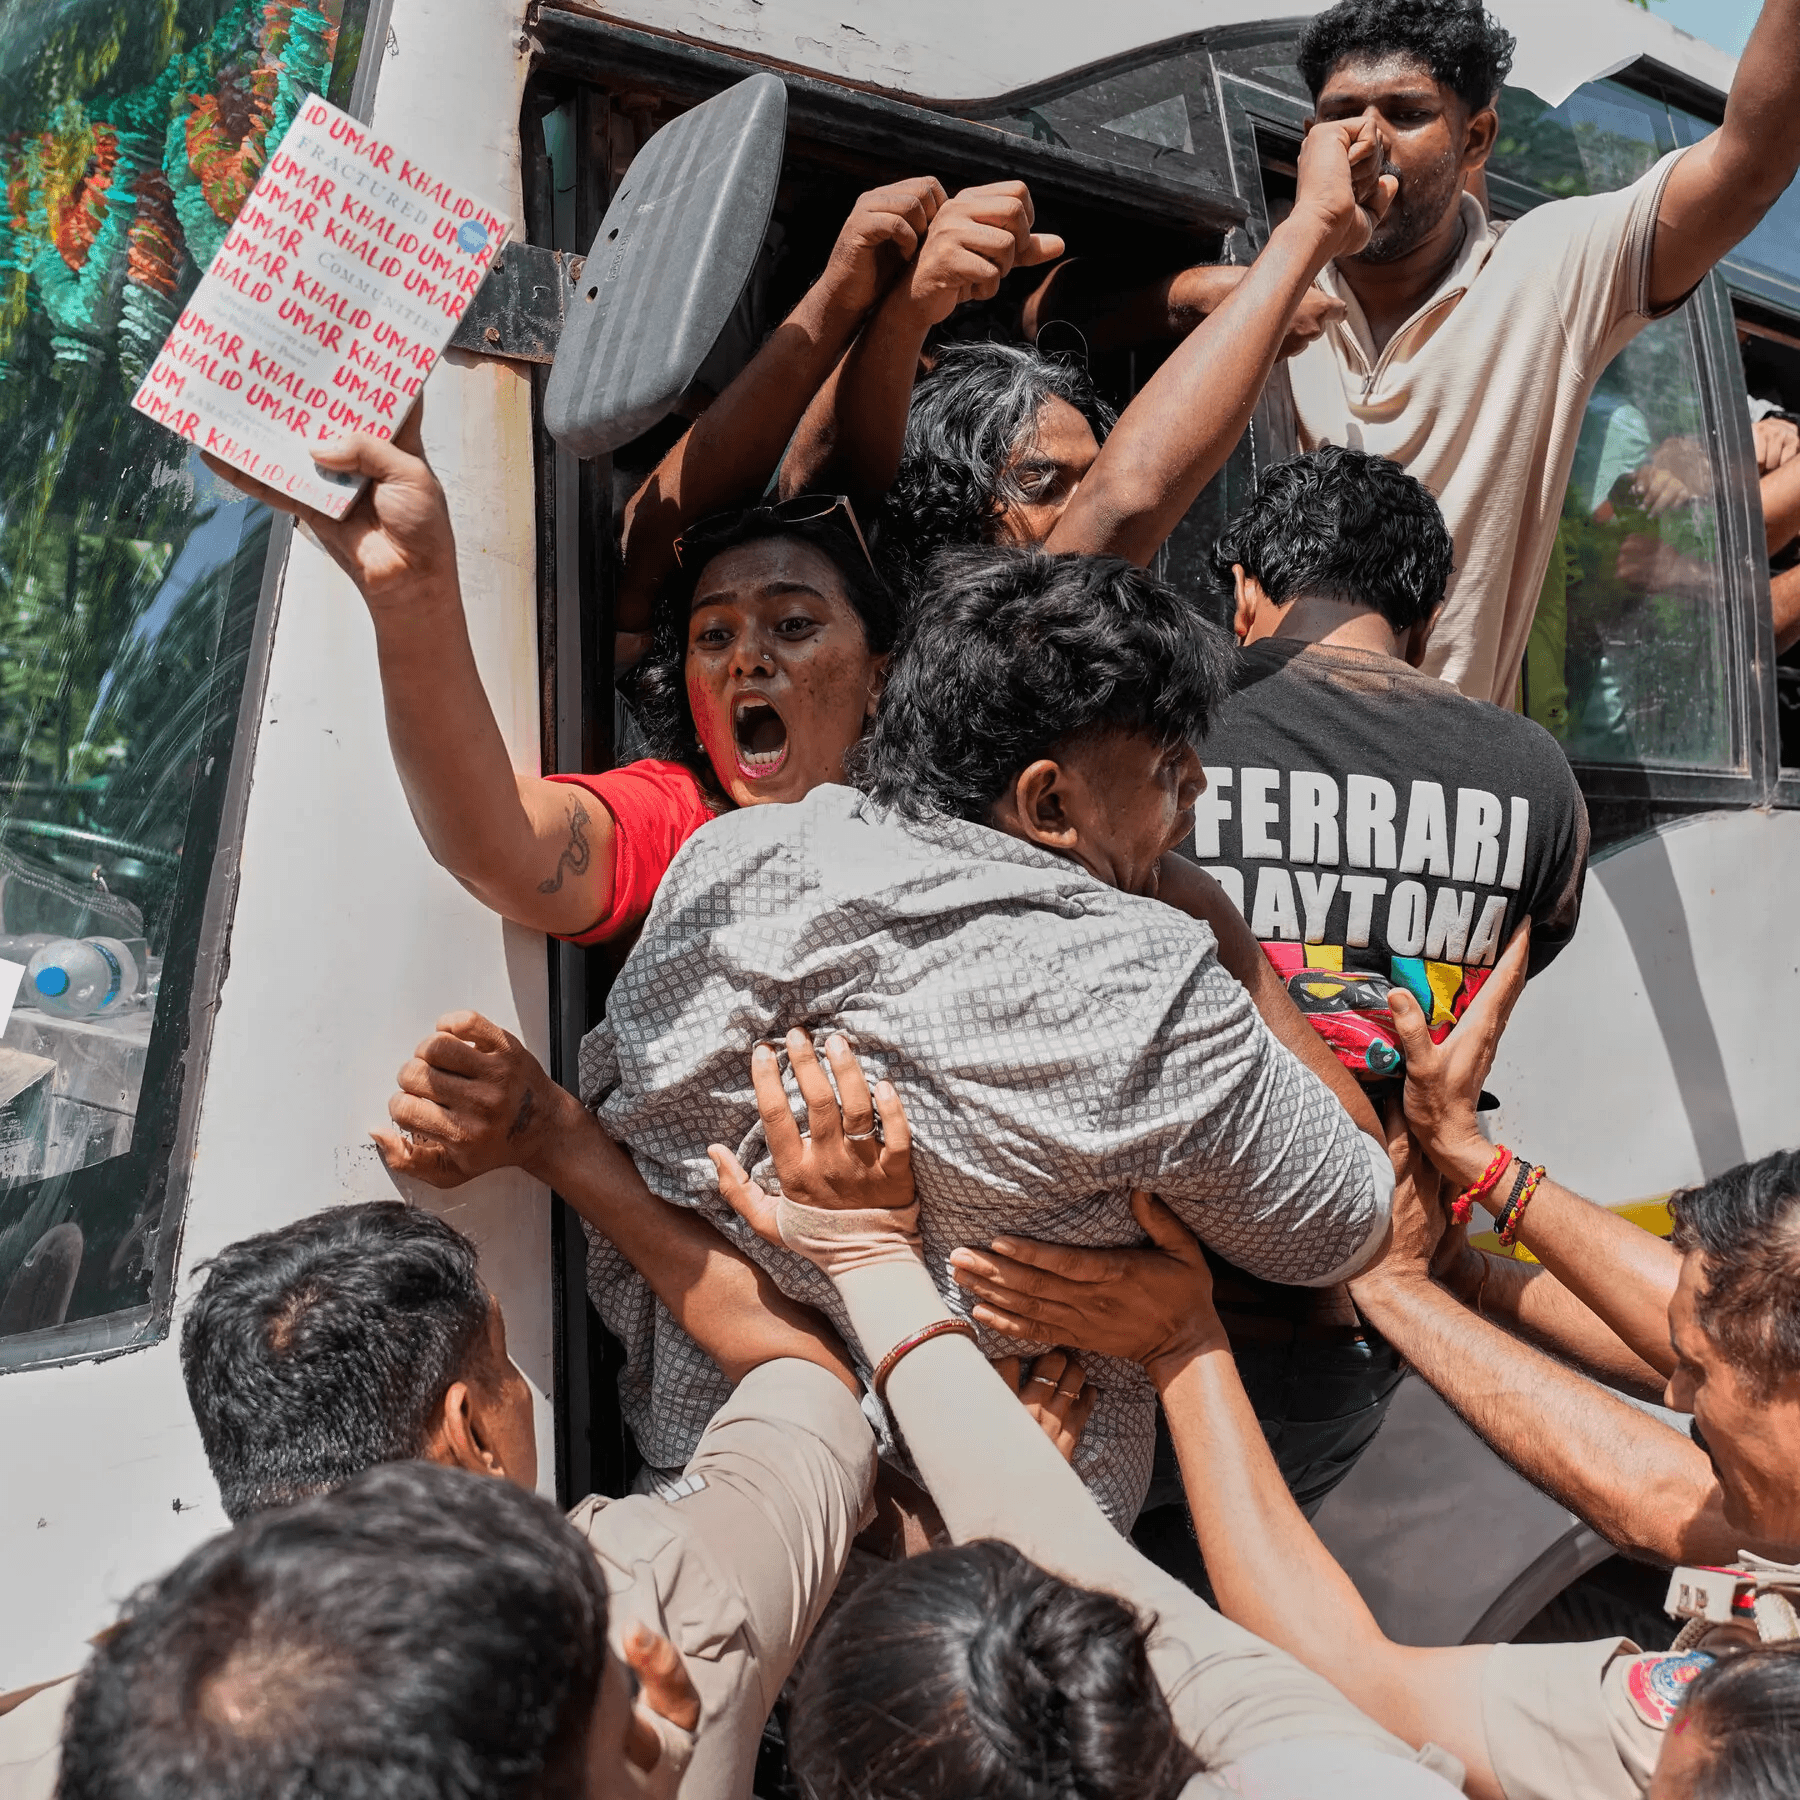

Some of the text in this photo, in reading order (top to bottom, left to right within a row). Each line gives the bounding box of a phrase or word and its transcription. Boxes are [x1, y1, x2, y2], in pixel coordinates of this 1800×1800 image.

[296, 135, 428, 226] FRACTURED
[305, 104, 328, 126] ID
[330, 118, 394, 173] UMAR
[399, 161, 474, 219] KHALID
[235, 199, 303, 257] UMAR
[252, 177, 466, 320] UMAR KHALID UMAR
[271, 152, 480, 296] UMAR KHALID UMAR
[212, 258, 272, 302] HALID
[279, 299, 343, 352] UMAR
[224, 231, 288, 283] UMAR
[292, 271, 372, 329] KHALID
[373, 321, 434, 373] UMAR
[152, 362, 186, 397] UM
[164, 333, 242, 390] KHALID
[247, 385, 312, 437] UMAR
[179, 310, 244, 362] UMAR
[249, 351, 327, 408] KHALID
[332, 366, 393, 419] UMAR
[137, 388, 200, 441] UMAR
[206, 427, 284, 482] KHALID
[1195, 767, 1529, 890] FERRARI
